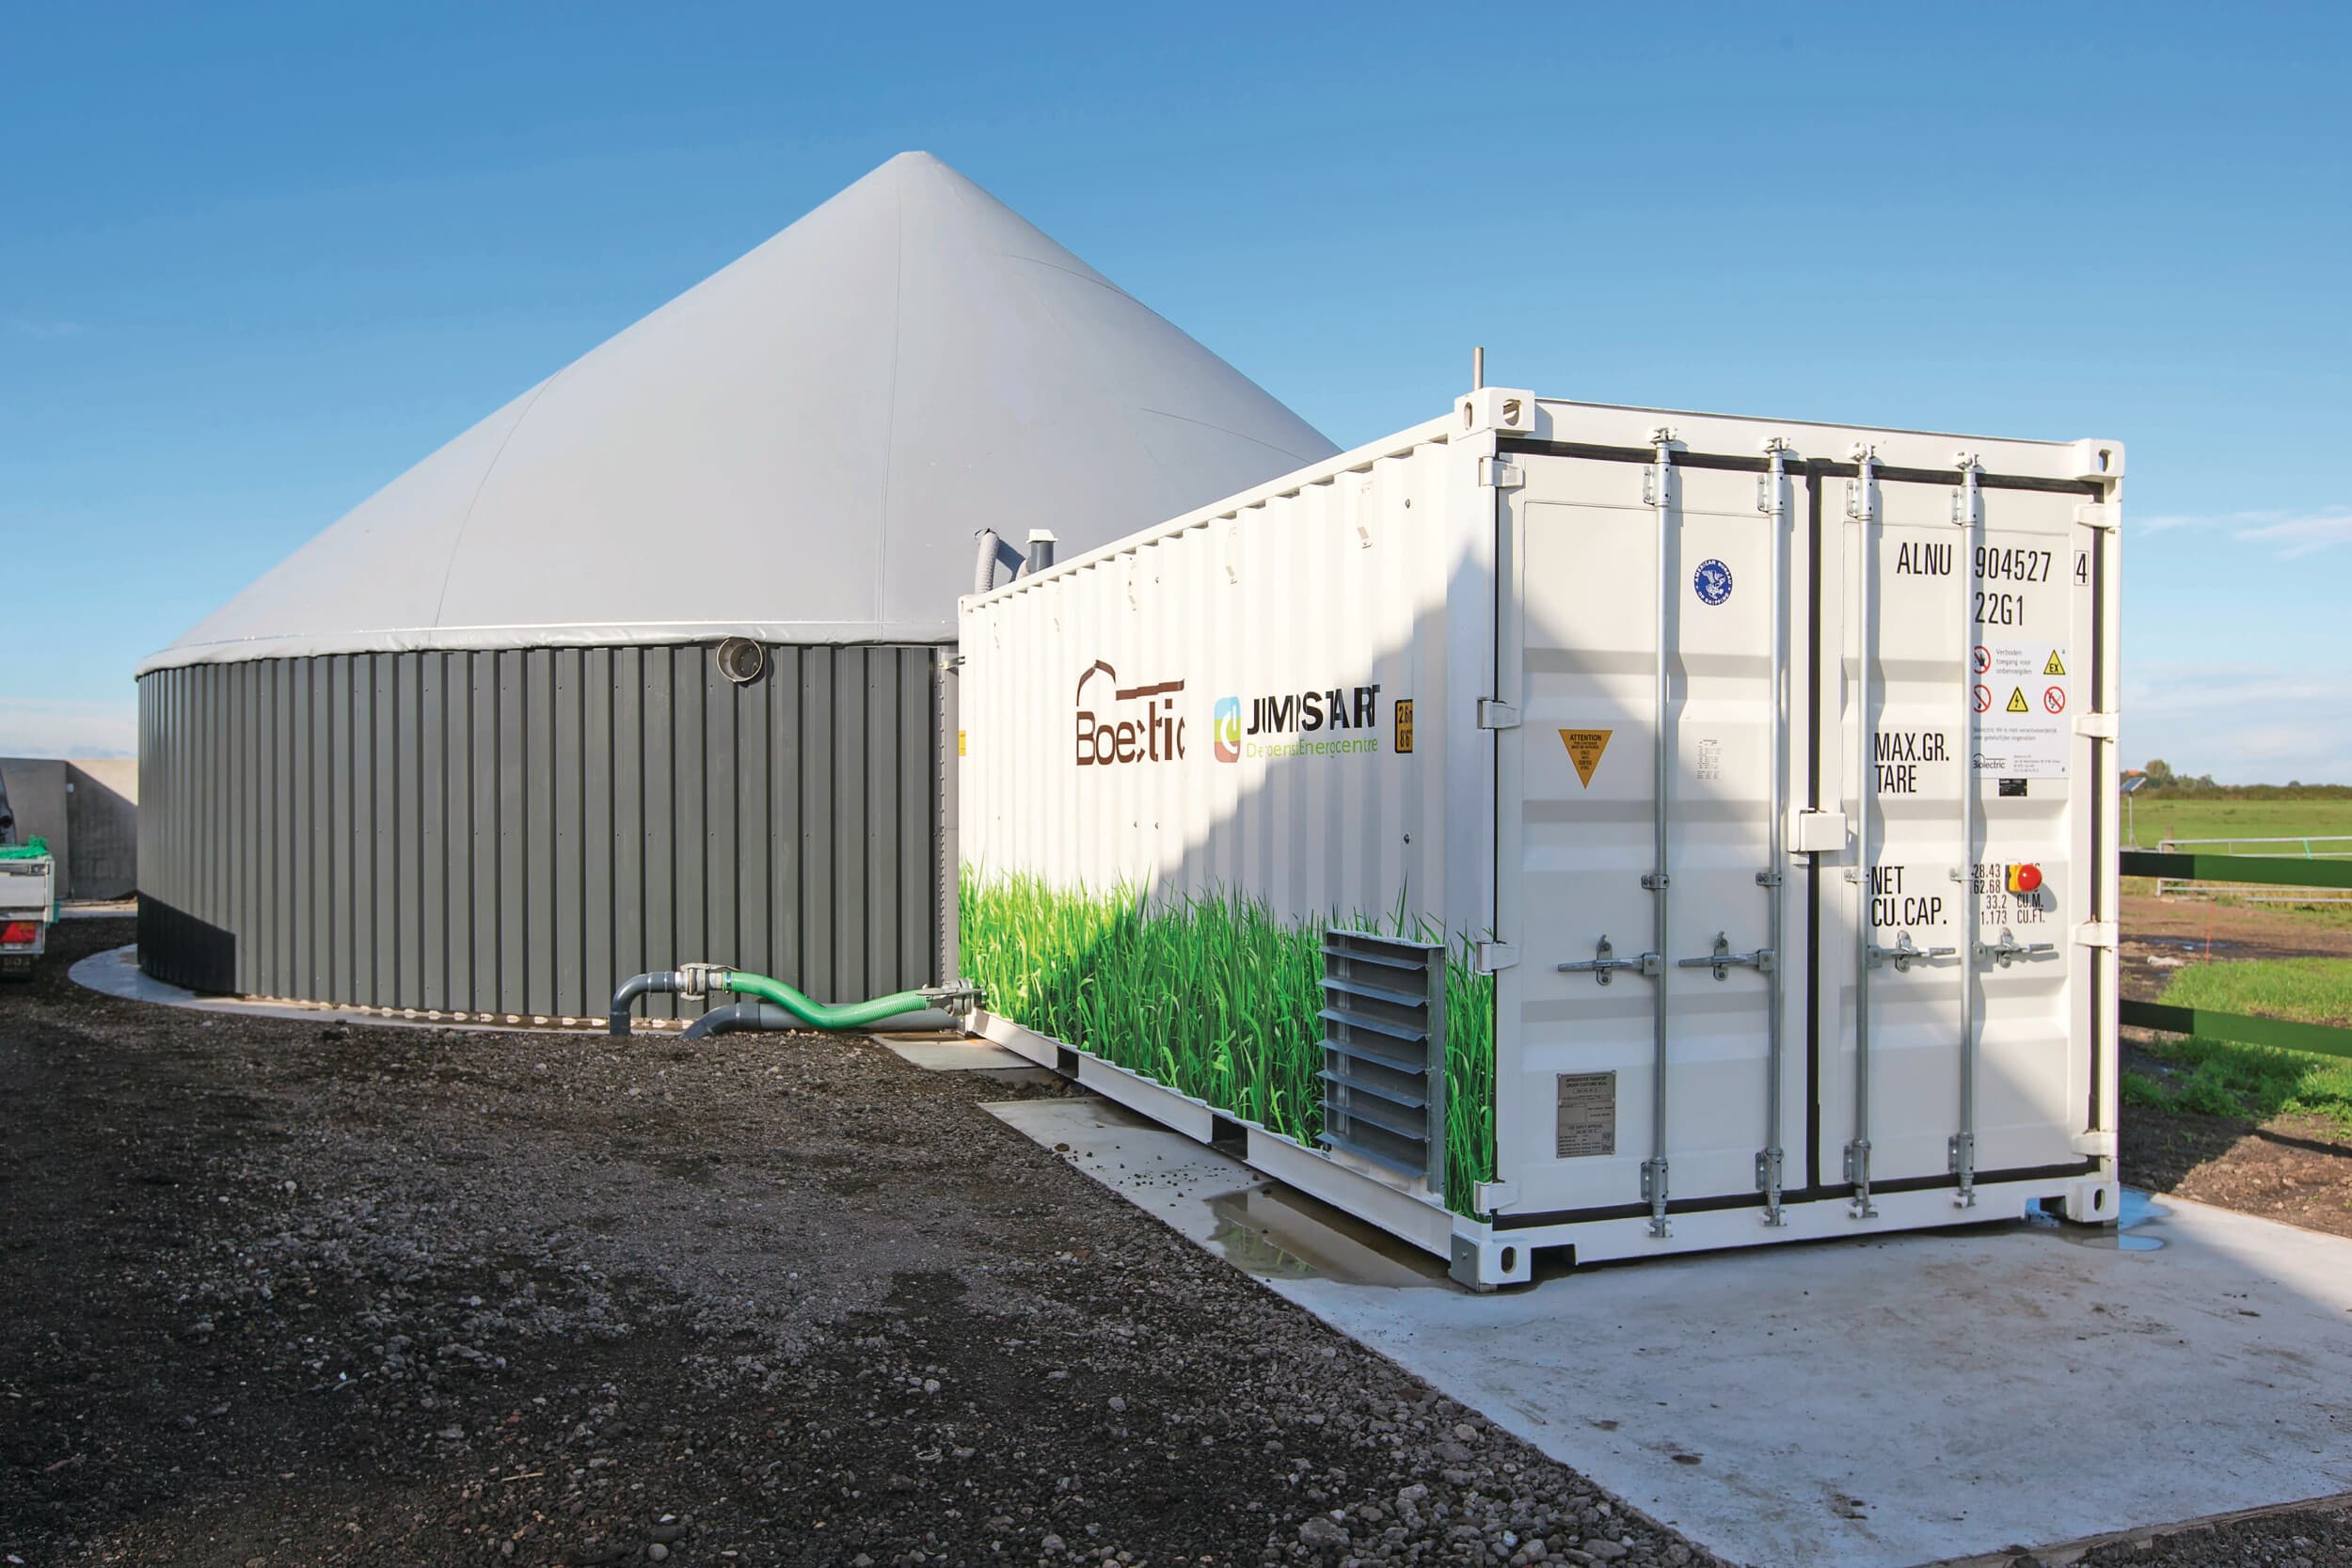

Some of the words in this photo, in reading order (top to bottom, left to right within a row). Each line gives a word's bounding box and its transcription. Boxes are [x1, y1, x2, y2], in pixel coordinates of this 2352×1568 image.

[1896, 542, 1952, 576] ALNU
[1975, 546, 2052, 582] 904527
[2075, 553, 2088, 583] 4
[1975, 592, 2024, 626] 22G1
[2049, 663, 2058, 673] EX
[1874, 732, 1949, 762] MAX.GR.
[1874, 765, 1917, 794] TARE
[1870, 865, 1904, 895] NET
[1986, 895, 2007, 910] 33.2
[2016, 894, 2044, 908] CU.M.
[1981, 910, 2008, 925] 1.173
[2016, 909, 2045, 924] CU.FT.
